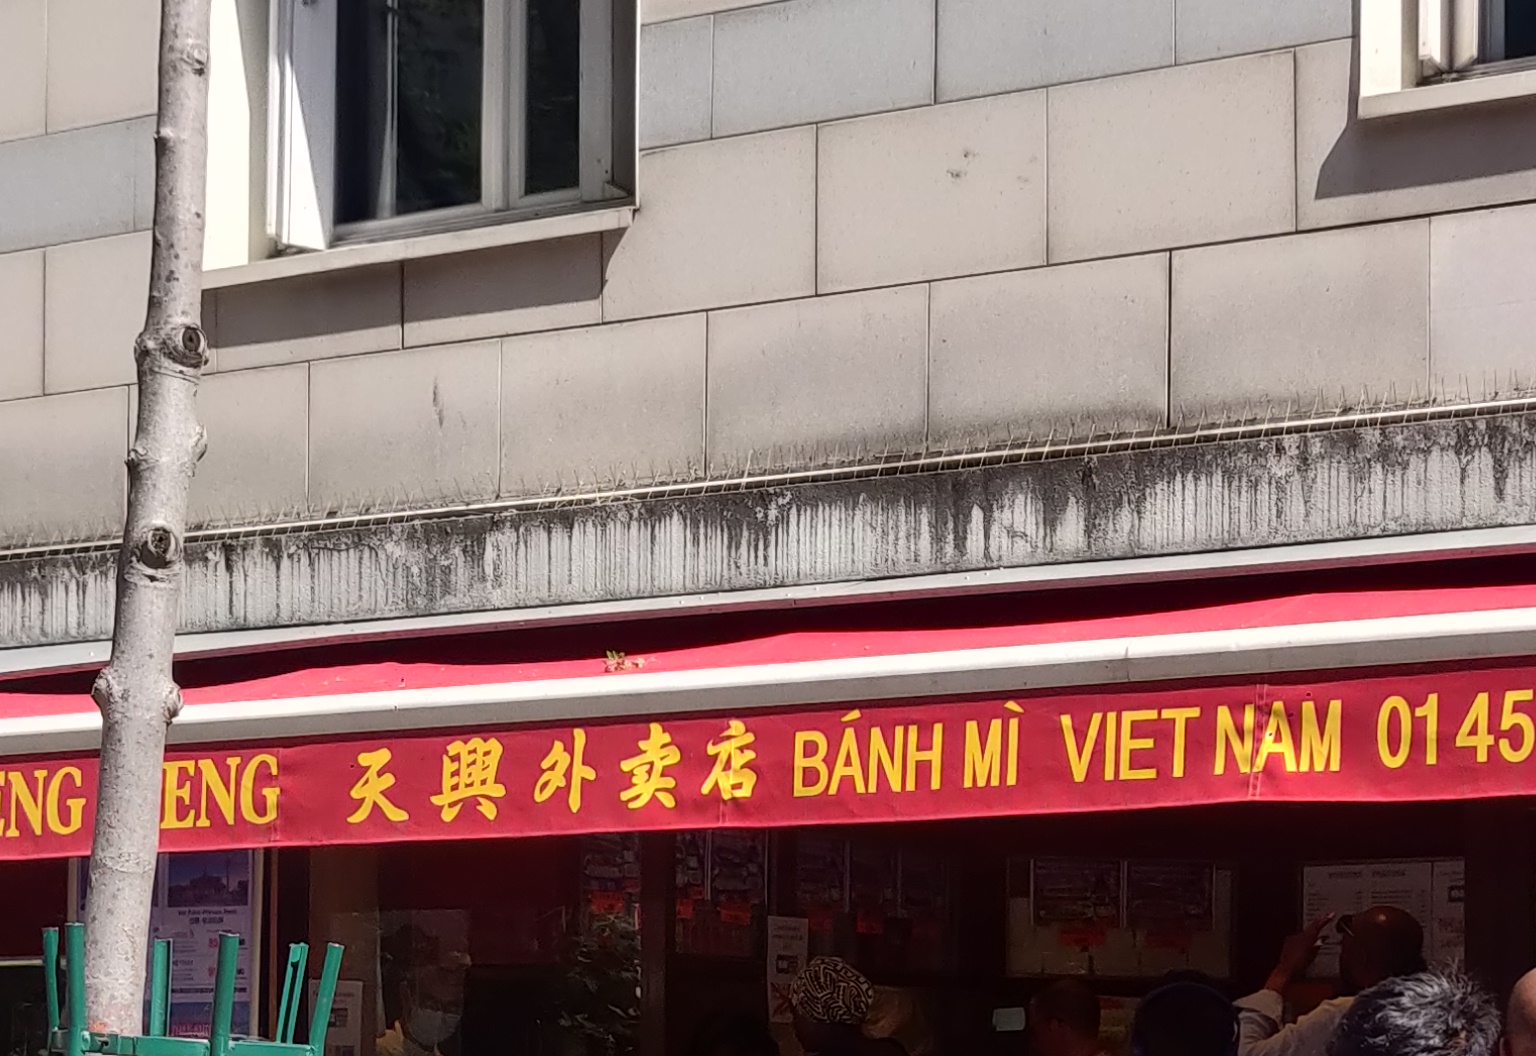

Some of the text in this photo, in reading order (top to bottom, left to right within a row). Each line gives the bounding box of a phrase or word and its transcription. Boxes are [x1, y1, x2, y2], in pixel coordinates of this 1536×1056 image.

[792, 708, 944, 798] BÁNH
[962, 700, 1026, 789] MÌ
[1059, 706, 1201, 783] VIET
[1213, 699, 1342, 776] NAM
[1376, 690, 1440, 769] 01
[1454, 688, 1535, 764] 45
[161, 754, 281, 830] ENG
